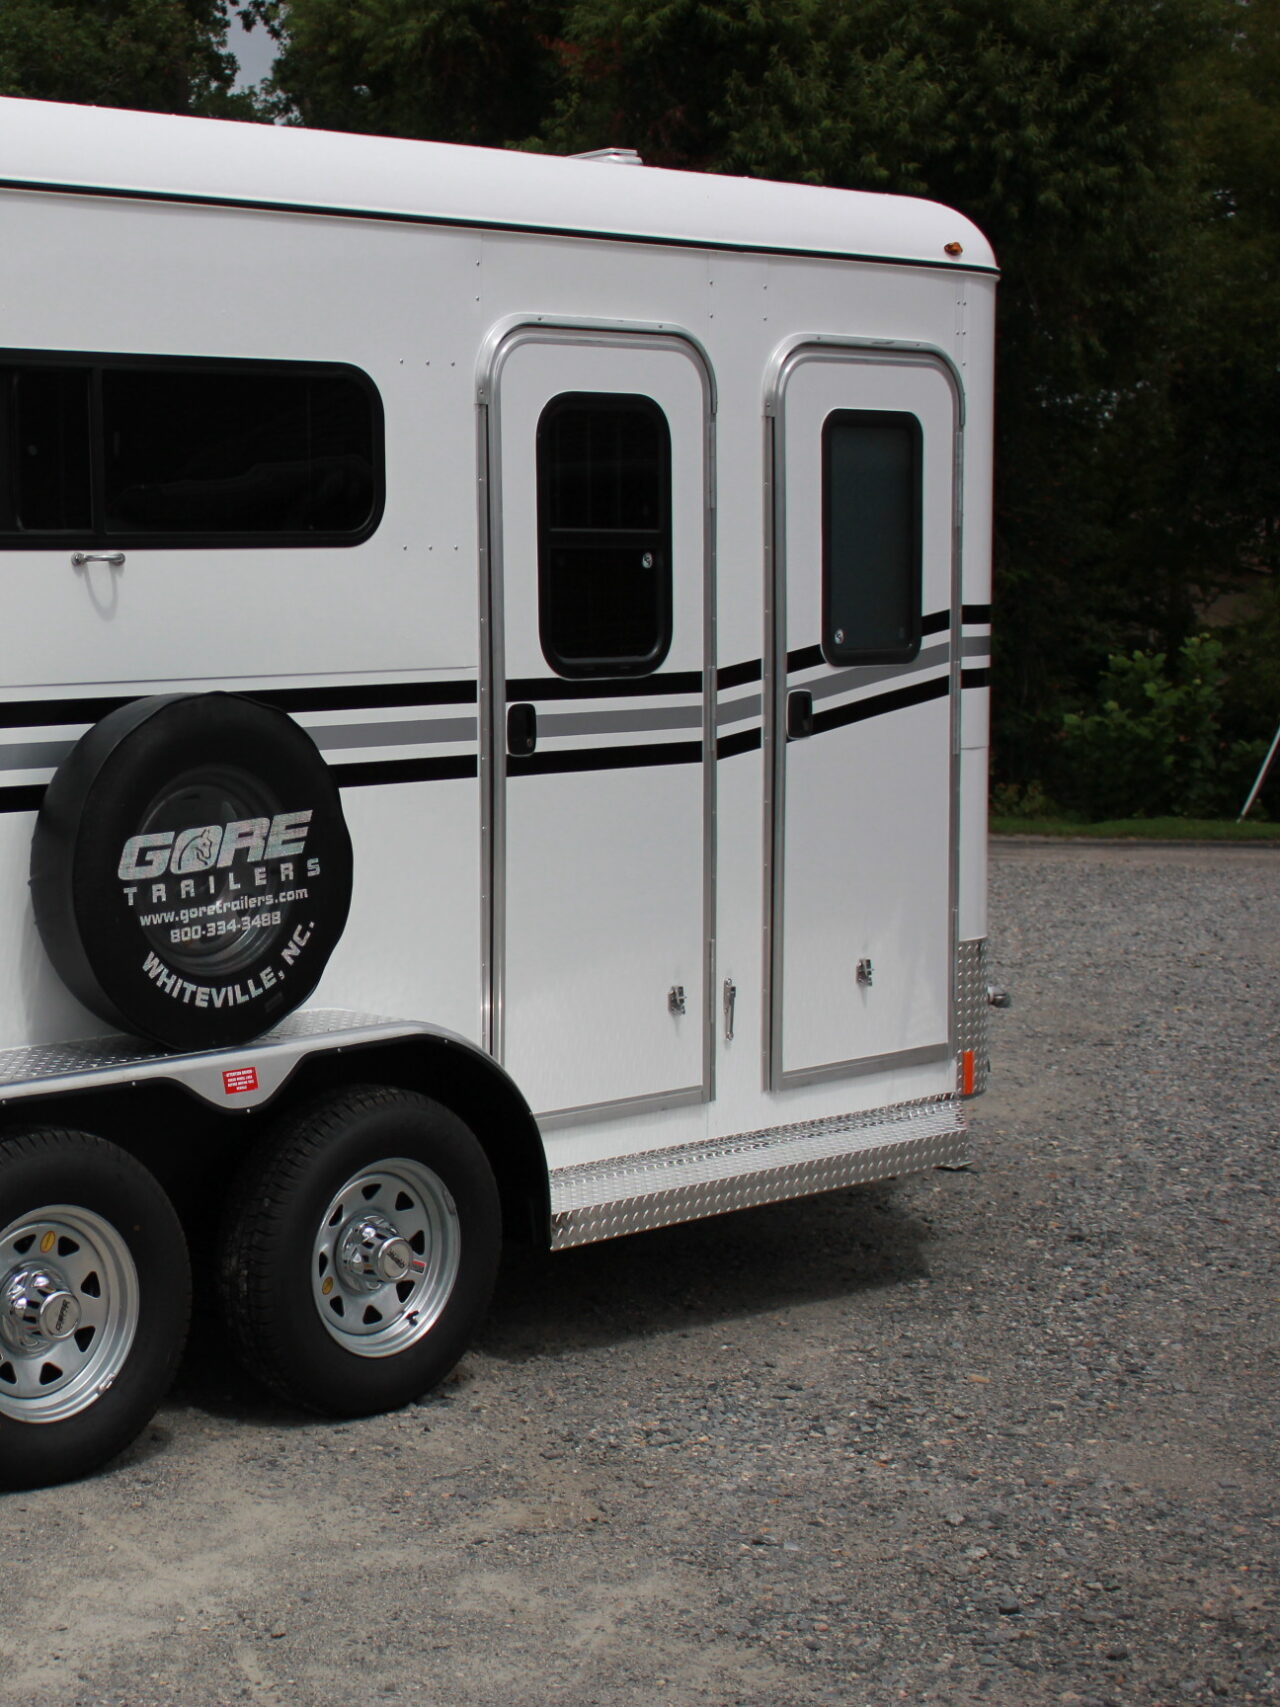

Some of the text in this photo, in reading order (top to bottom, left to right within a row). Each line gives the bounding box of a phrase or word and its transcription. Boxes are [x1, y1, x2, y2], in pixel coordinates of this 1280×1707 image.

[118, 809, 314, 881] GORE
[123, 857, 321, 906] TRAILERS
[139, 888, 309, 927] www.goretrailers.com
[141, 920, 316, 1008] WHITEVILLE, NC.
